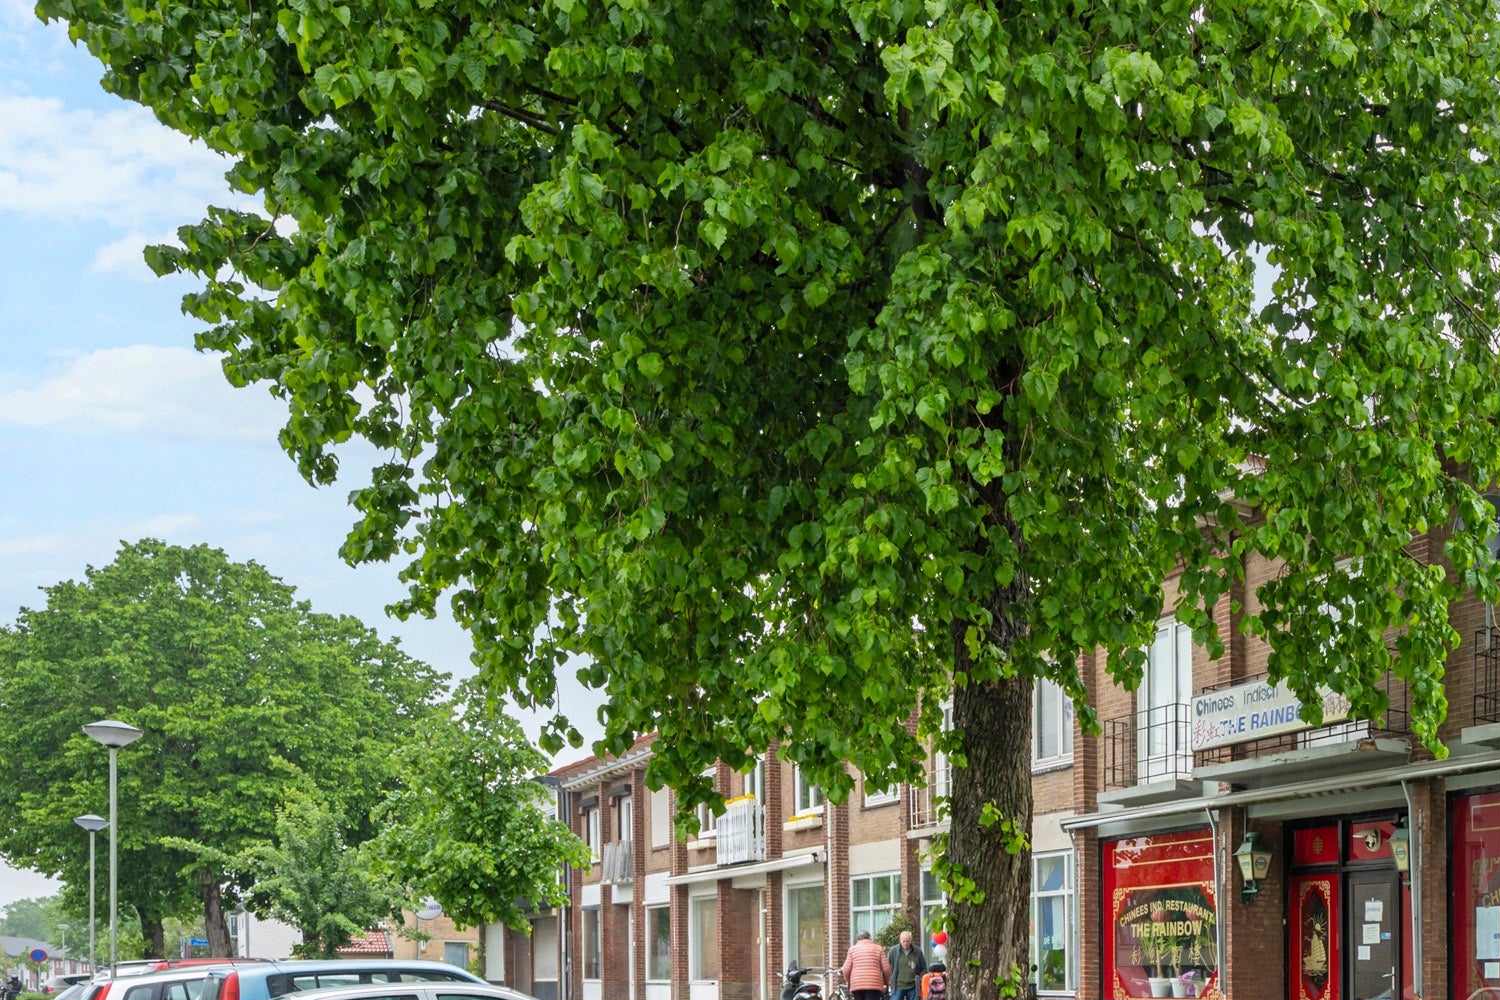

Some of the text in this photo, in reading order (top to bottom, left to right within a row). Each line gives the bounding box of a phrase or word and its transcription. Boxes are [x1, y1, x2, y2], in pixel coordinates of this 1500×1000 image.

[1196, 695, 1235, 717] Chinees
[1220, 716, 1246, 737] THE
[1120, 900, 1215, 927] CHINEES IND. RESTAURANT
[1131, 920, 1203, 938] THE RAINBOW
